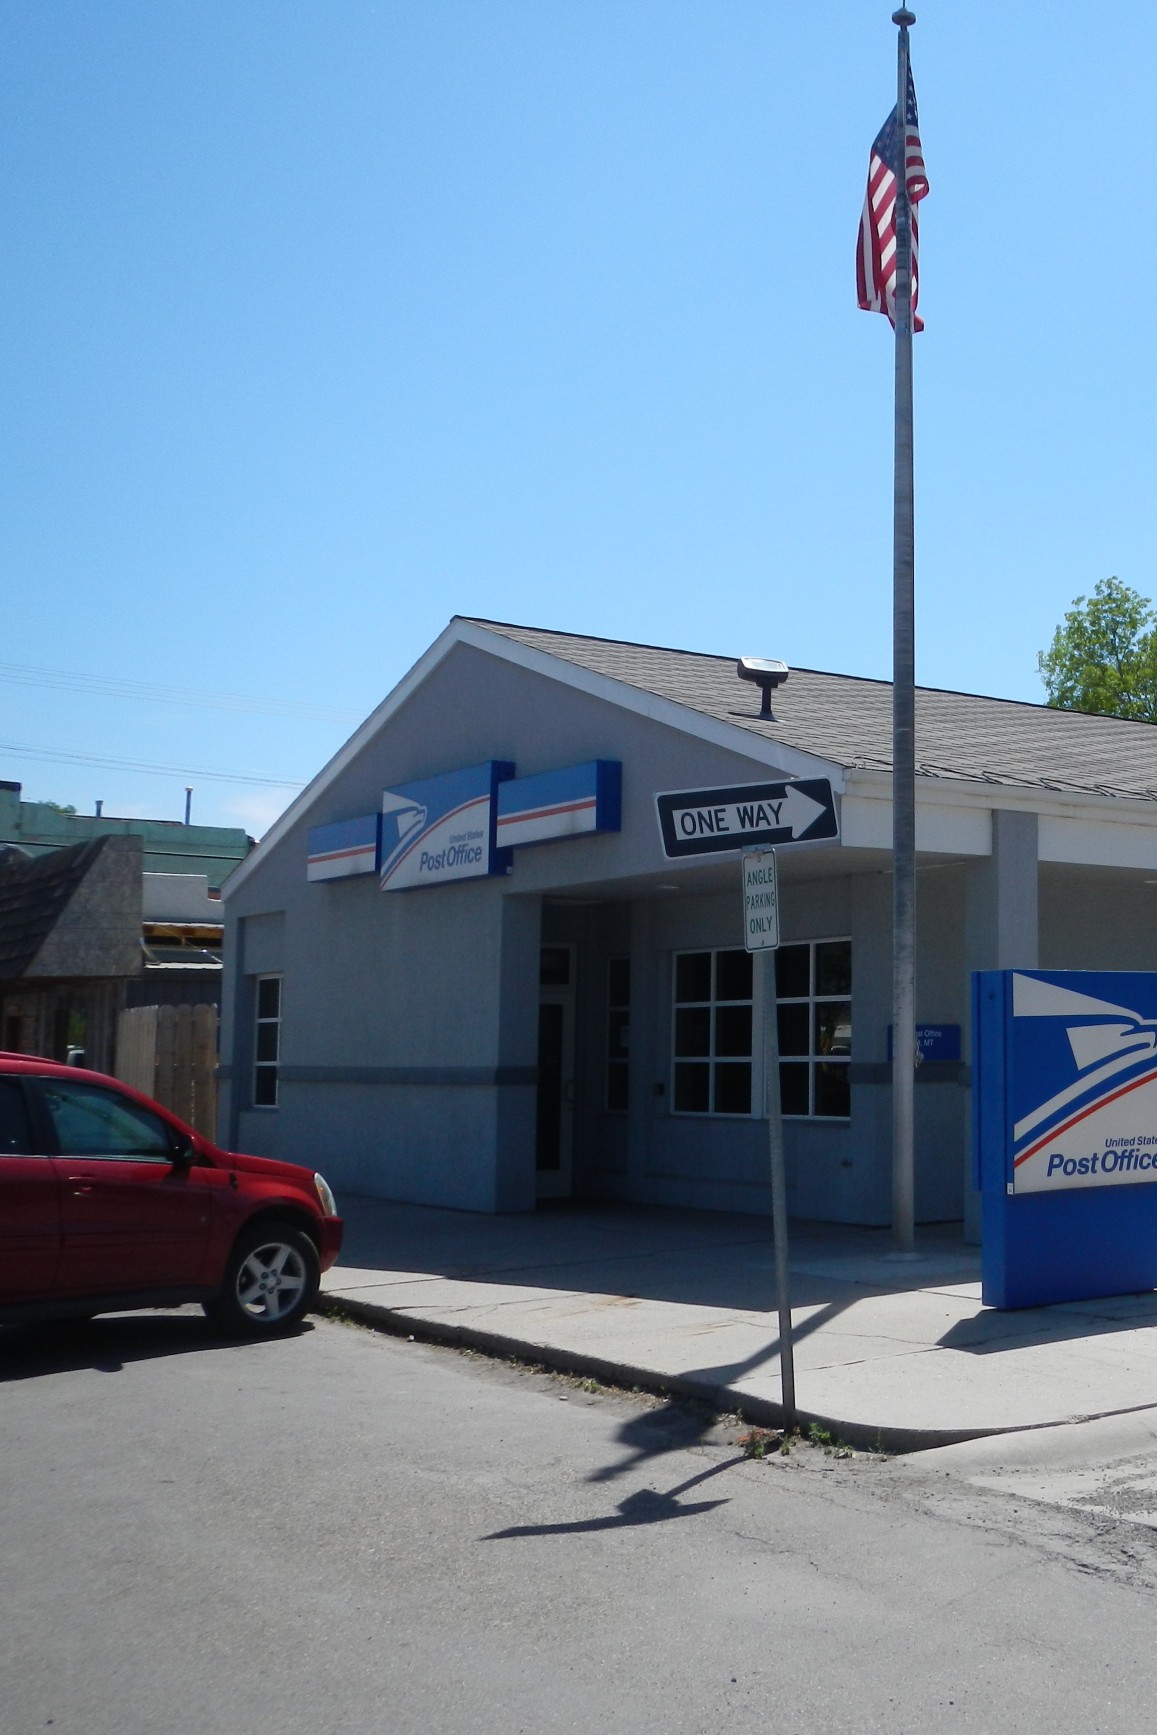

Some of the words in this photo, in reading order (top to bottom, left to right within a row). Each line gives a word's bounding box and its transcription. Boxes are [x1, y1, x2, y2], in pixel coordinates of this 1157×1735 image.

[680, 808, 729, 836] ONE
[736, 802, 783, 829] WAY
[419, 848, 446, 872] Post
[447, 843, 482, 867] Office
[746, 867, 773, 886] ANGLE
[746, 891, 775, 910] PARKING
[749, 916, 773, 934] ONLY
[1105, 1137, 1135, 1148] United
[1047, 1152, 1099, 1177] Post
